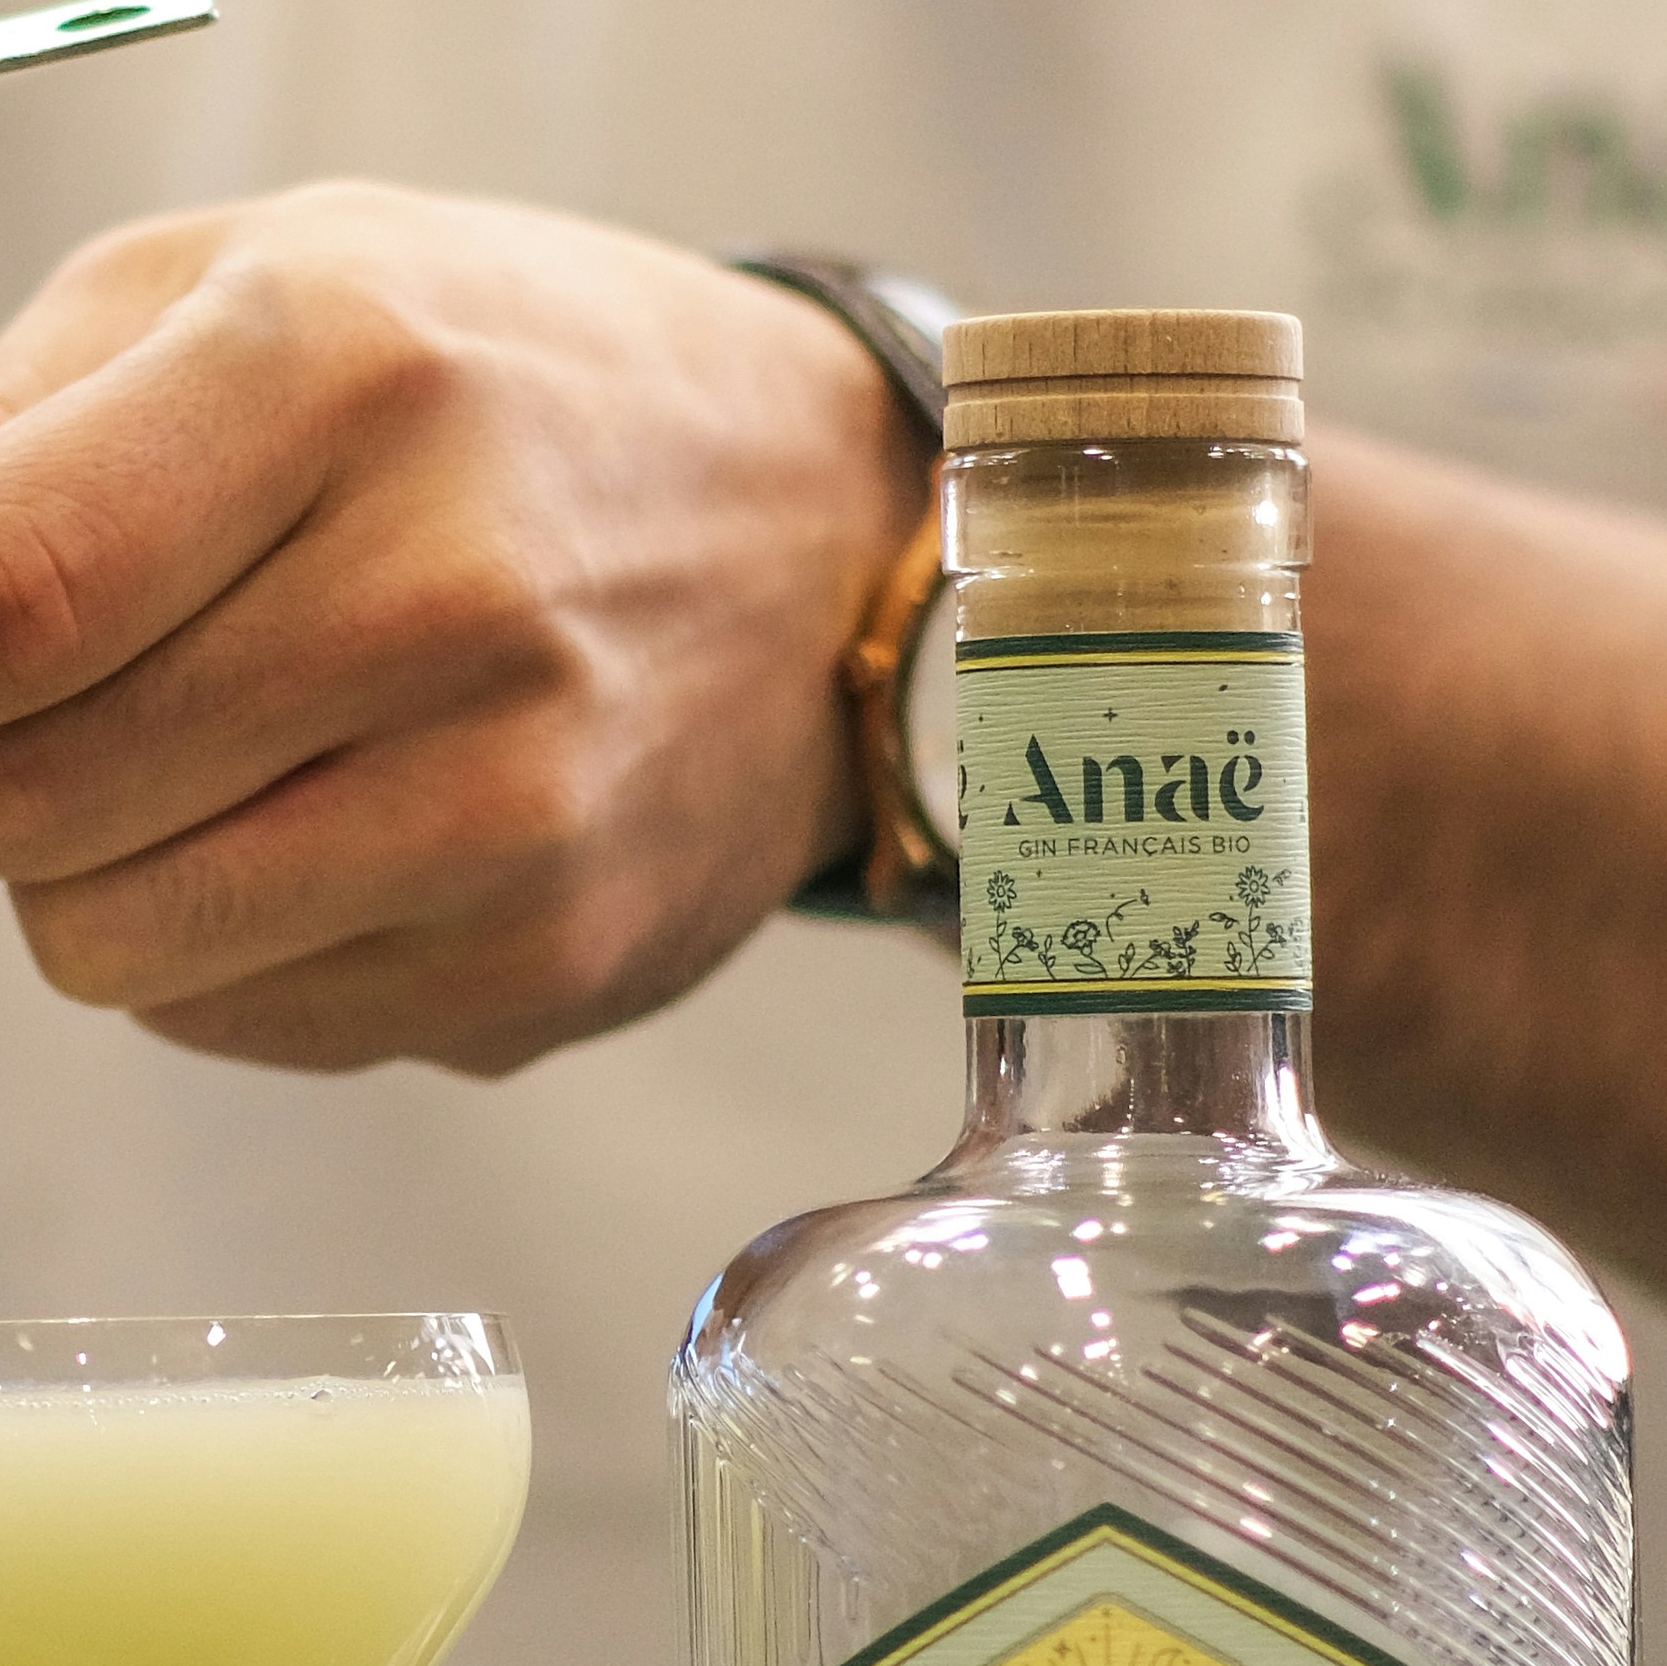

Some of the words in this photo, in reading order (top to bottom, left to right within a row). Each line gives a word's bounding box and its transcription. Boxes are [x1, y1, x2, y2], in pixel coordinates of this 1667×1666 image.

[1002, 729, 1265, 826] Anaë
[1018, 838, 1057, 858] GIN
[1067, 835, 1202, 857] FRANÇAIS
[1212, 834, 1251, 854] BIO
